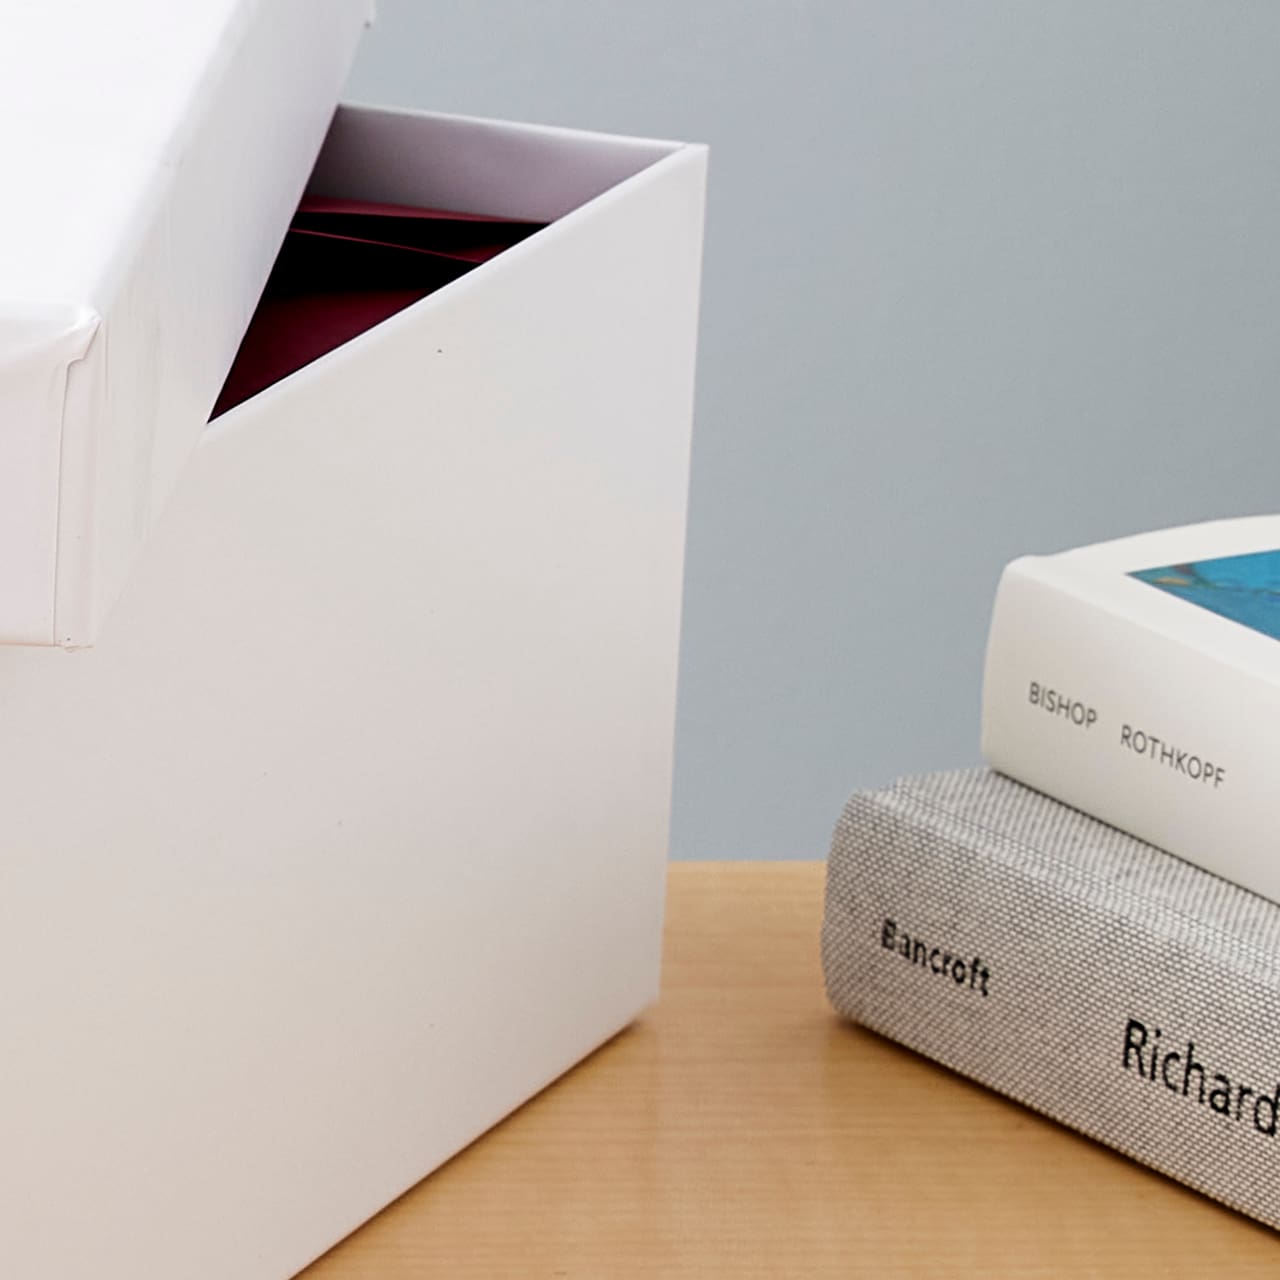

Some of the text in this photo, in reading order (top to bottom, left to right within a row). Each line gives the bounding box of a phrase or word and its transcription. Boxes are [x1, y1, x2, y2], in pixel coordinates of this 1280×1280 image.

[1028, 681, 1226, 788] BISHOP ROTHKOPF
[881, 918, 991, 997] Bancroft
[1123, 1018, 1280, 1137] Richard
